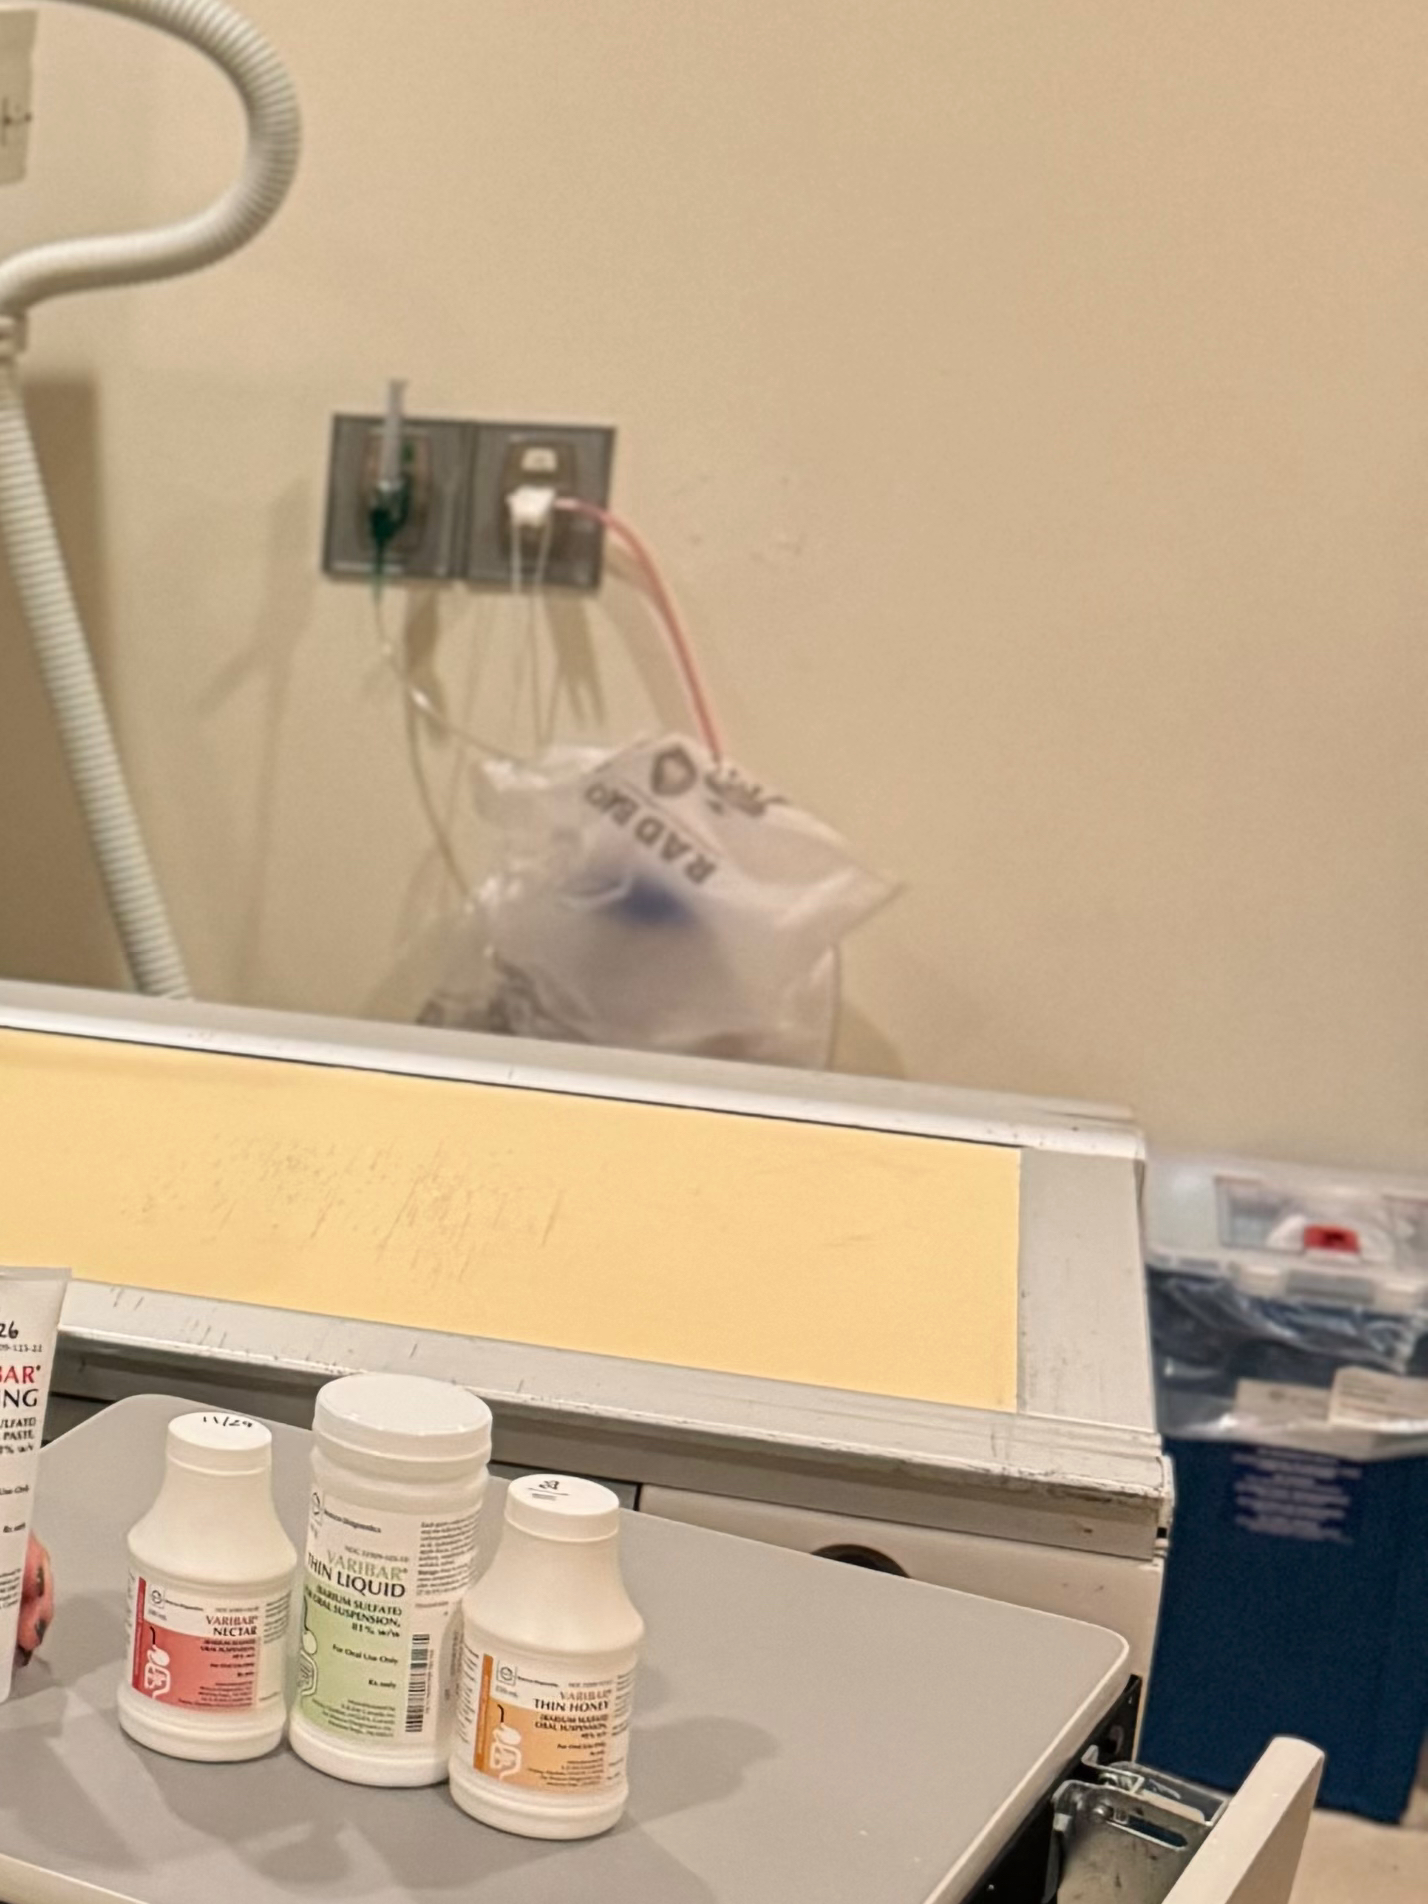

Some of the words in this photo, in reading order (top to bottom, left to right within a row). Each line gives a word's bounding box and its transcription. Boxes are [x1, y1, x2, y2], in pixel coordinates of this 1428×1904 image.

[337, 1570, 407, 1598] LIQUID
[213, 1626, 257, 1637] NECTAR
[534, 1698, 566, 1712] THIN
